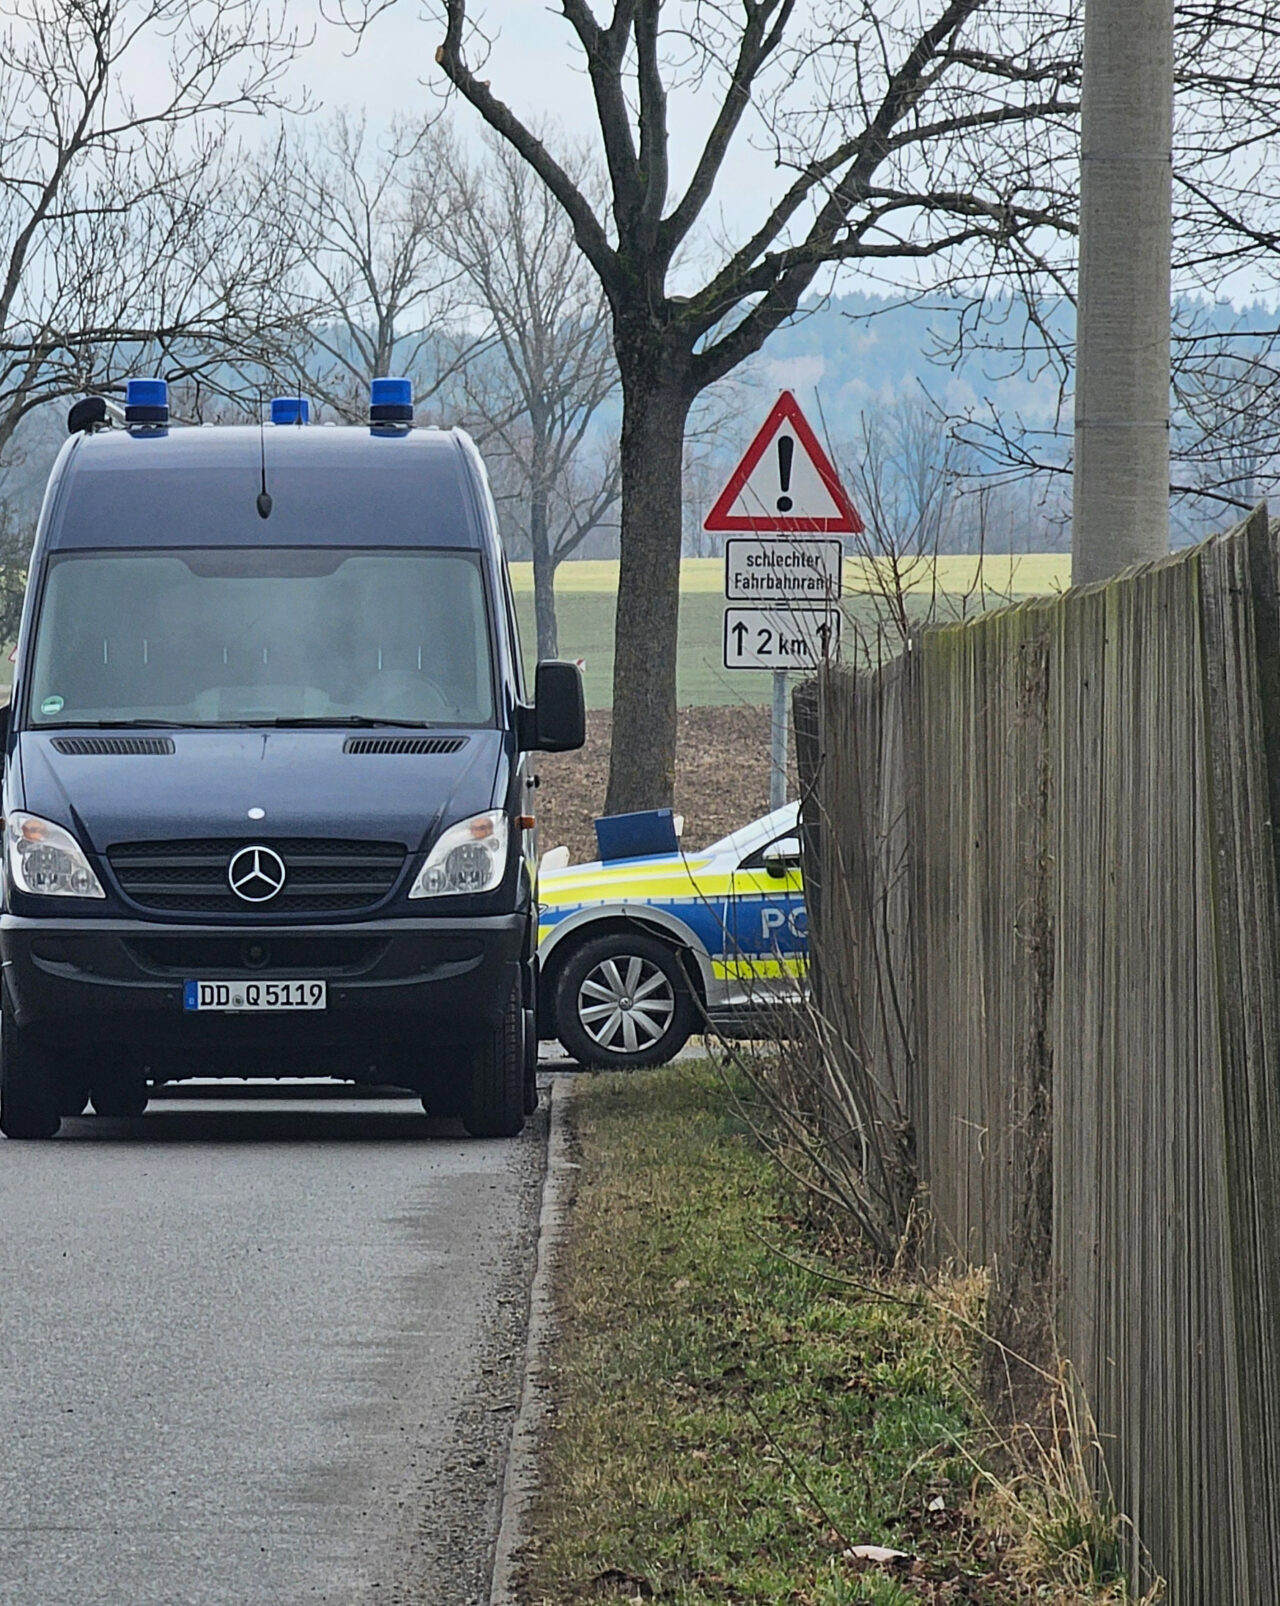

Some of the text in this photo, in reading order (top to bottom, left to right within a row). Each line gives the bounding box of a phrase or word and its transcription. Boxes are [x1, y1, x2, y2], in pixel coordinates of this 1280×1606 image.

[746, 550, 820, 567] schlechter
[756, 629, 807, 655] 2 km
[200, 985, 230, 1006] DD
[246, 984, 260, 1006] Q
[265, 984, 323, 1006] 5119
